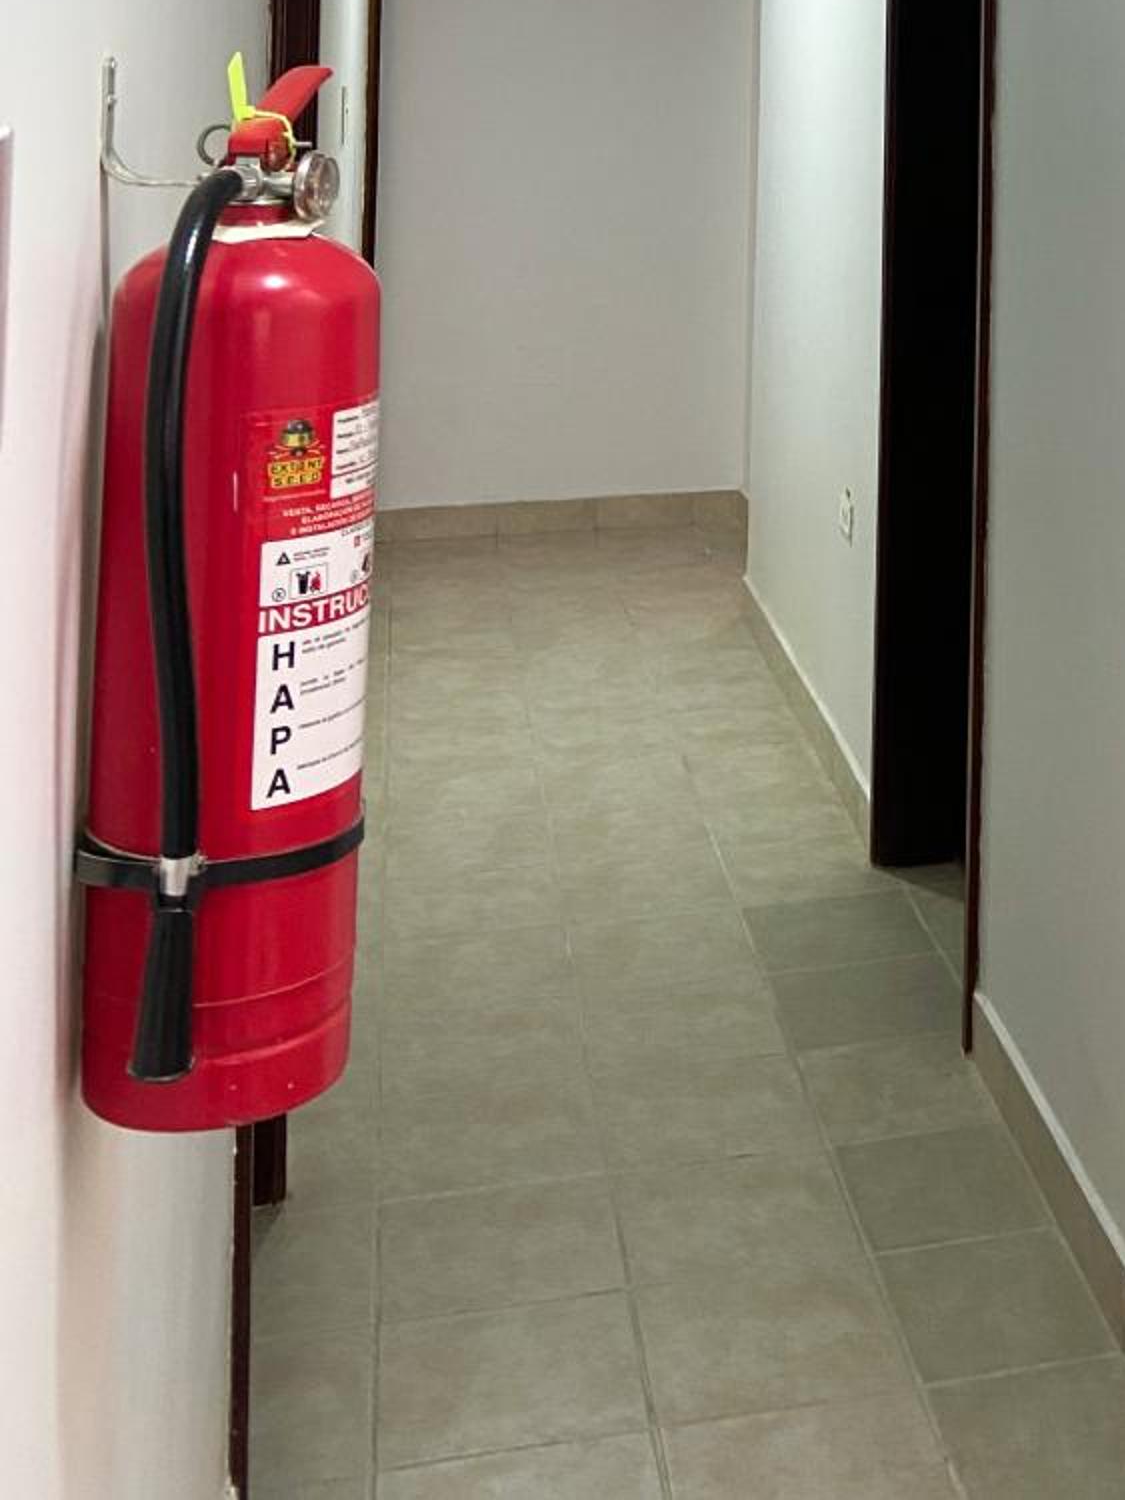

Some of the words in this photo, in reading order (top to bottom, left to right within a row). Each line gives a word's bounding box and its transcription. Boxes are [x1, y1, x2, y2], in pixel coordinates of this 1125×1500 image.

[272, 641, 295, 671] H
[270, 684, 295, 714] A
[270, 726, 292, 755] P
[266, 768, 291, 798] A
